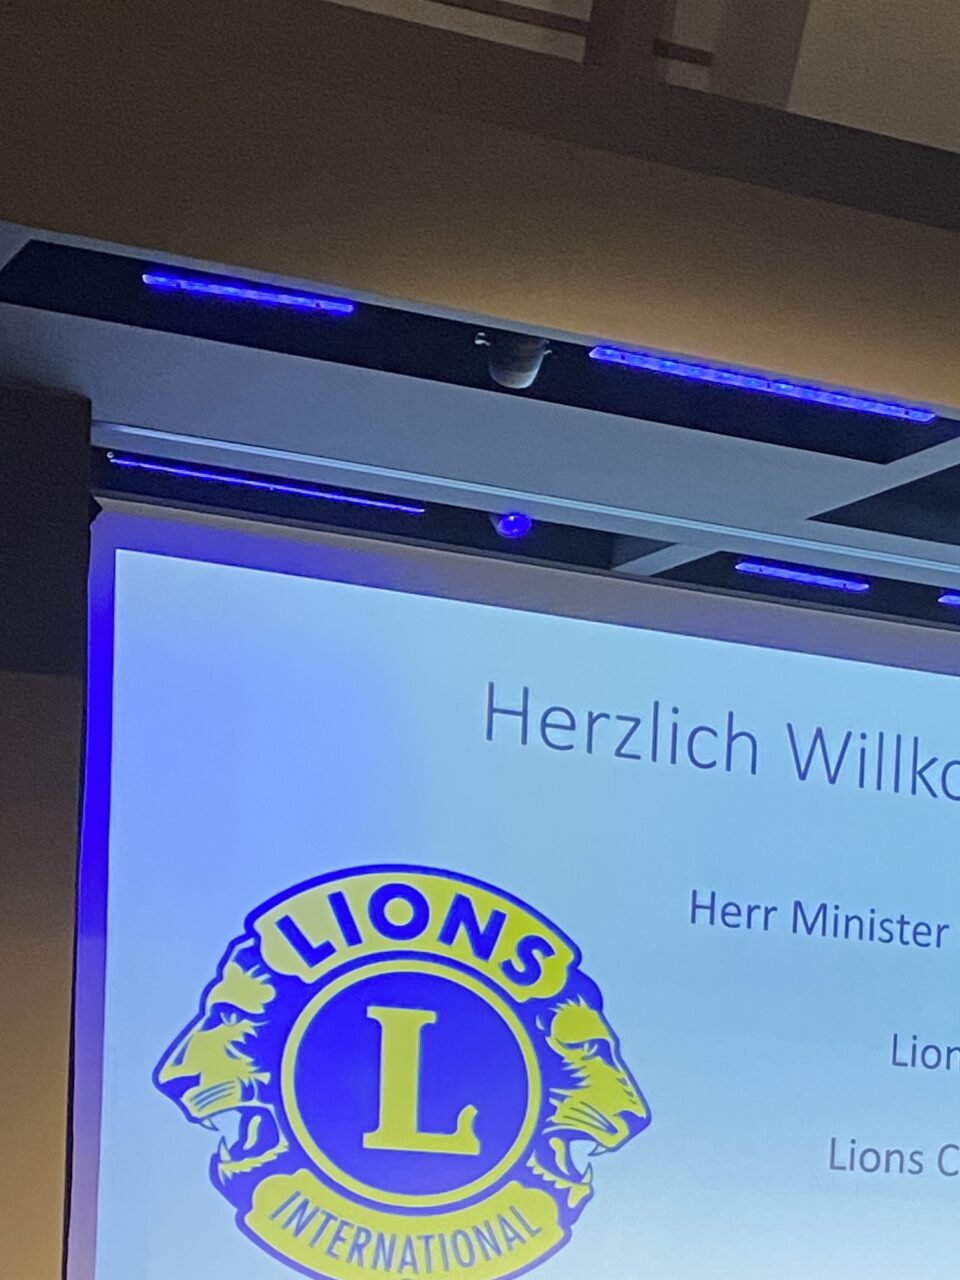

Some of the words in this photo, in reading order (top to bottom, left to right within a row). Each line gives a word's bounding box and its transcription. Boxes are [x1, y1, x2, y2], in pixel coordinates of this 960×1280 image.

[485, 681, 759, 777] Herzlich
[275, 882, 556, 987] LIONS
[689, 889, 779, 932] Herr
[791, 900, 950, 949] Minister
[362, 1006, 481, 1155] L
[828, 1136, 925, 1176] Lions
[269, 1189, 543, 1274] INTERNATIONAL
